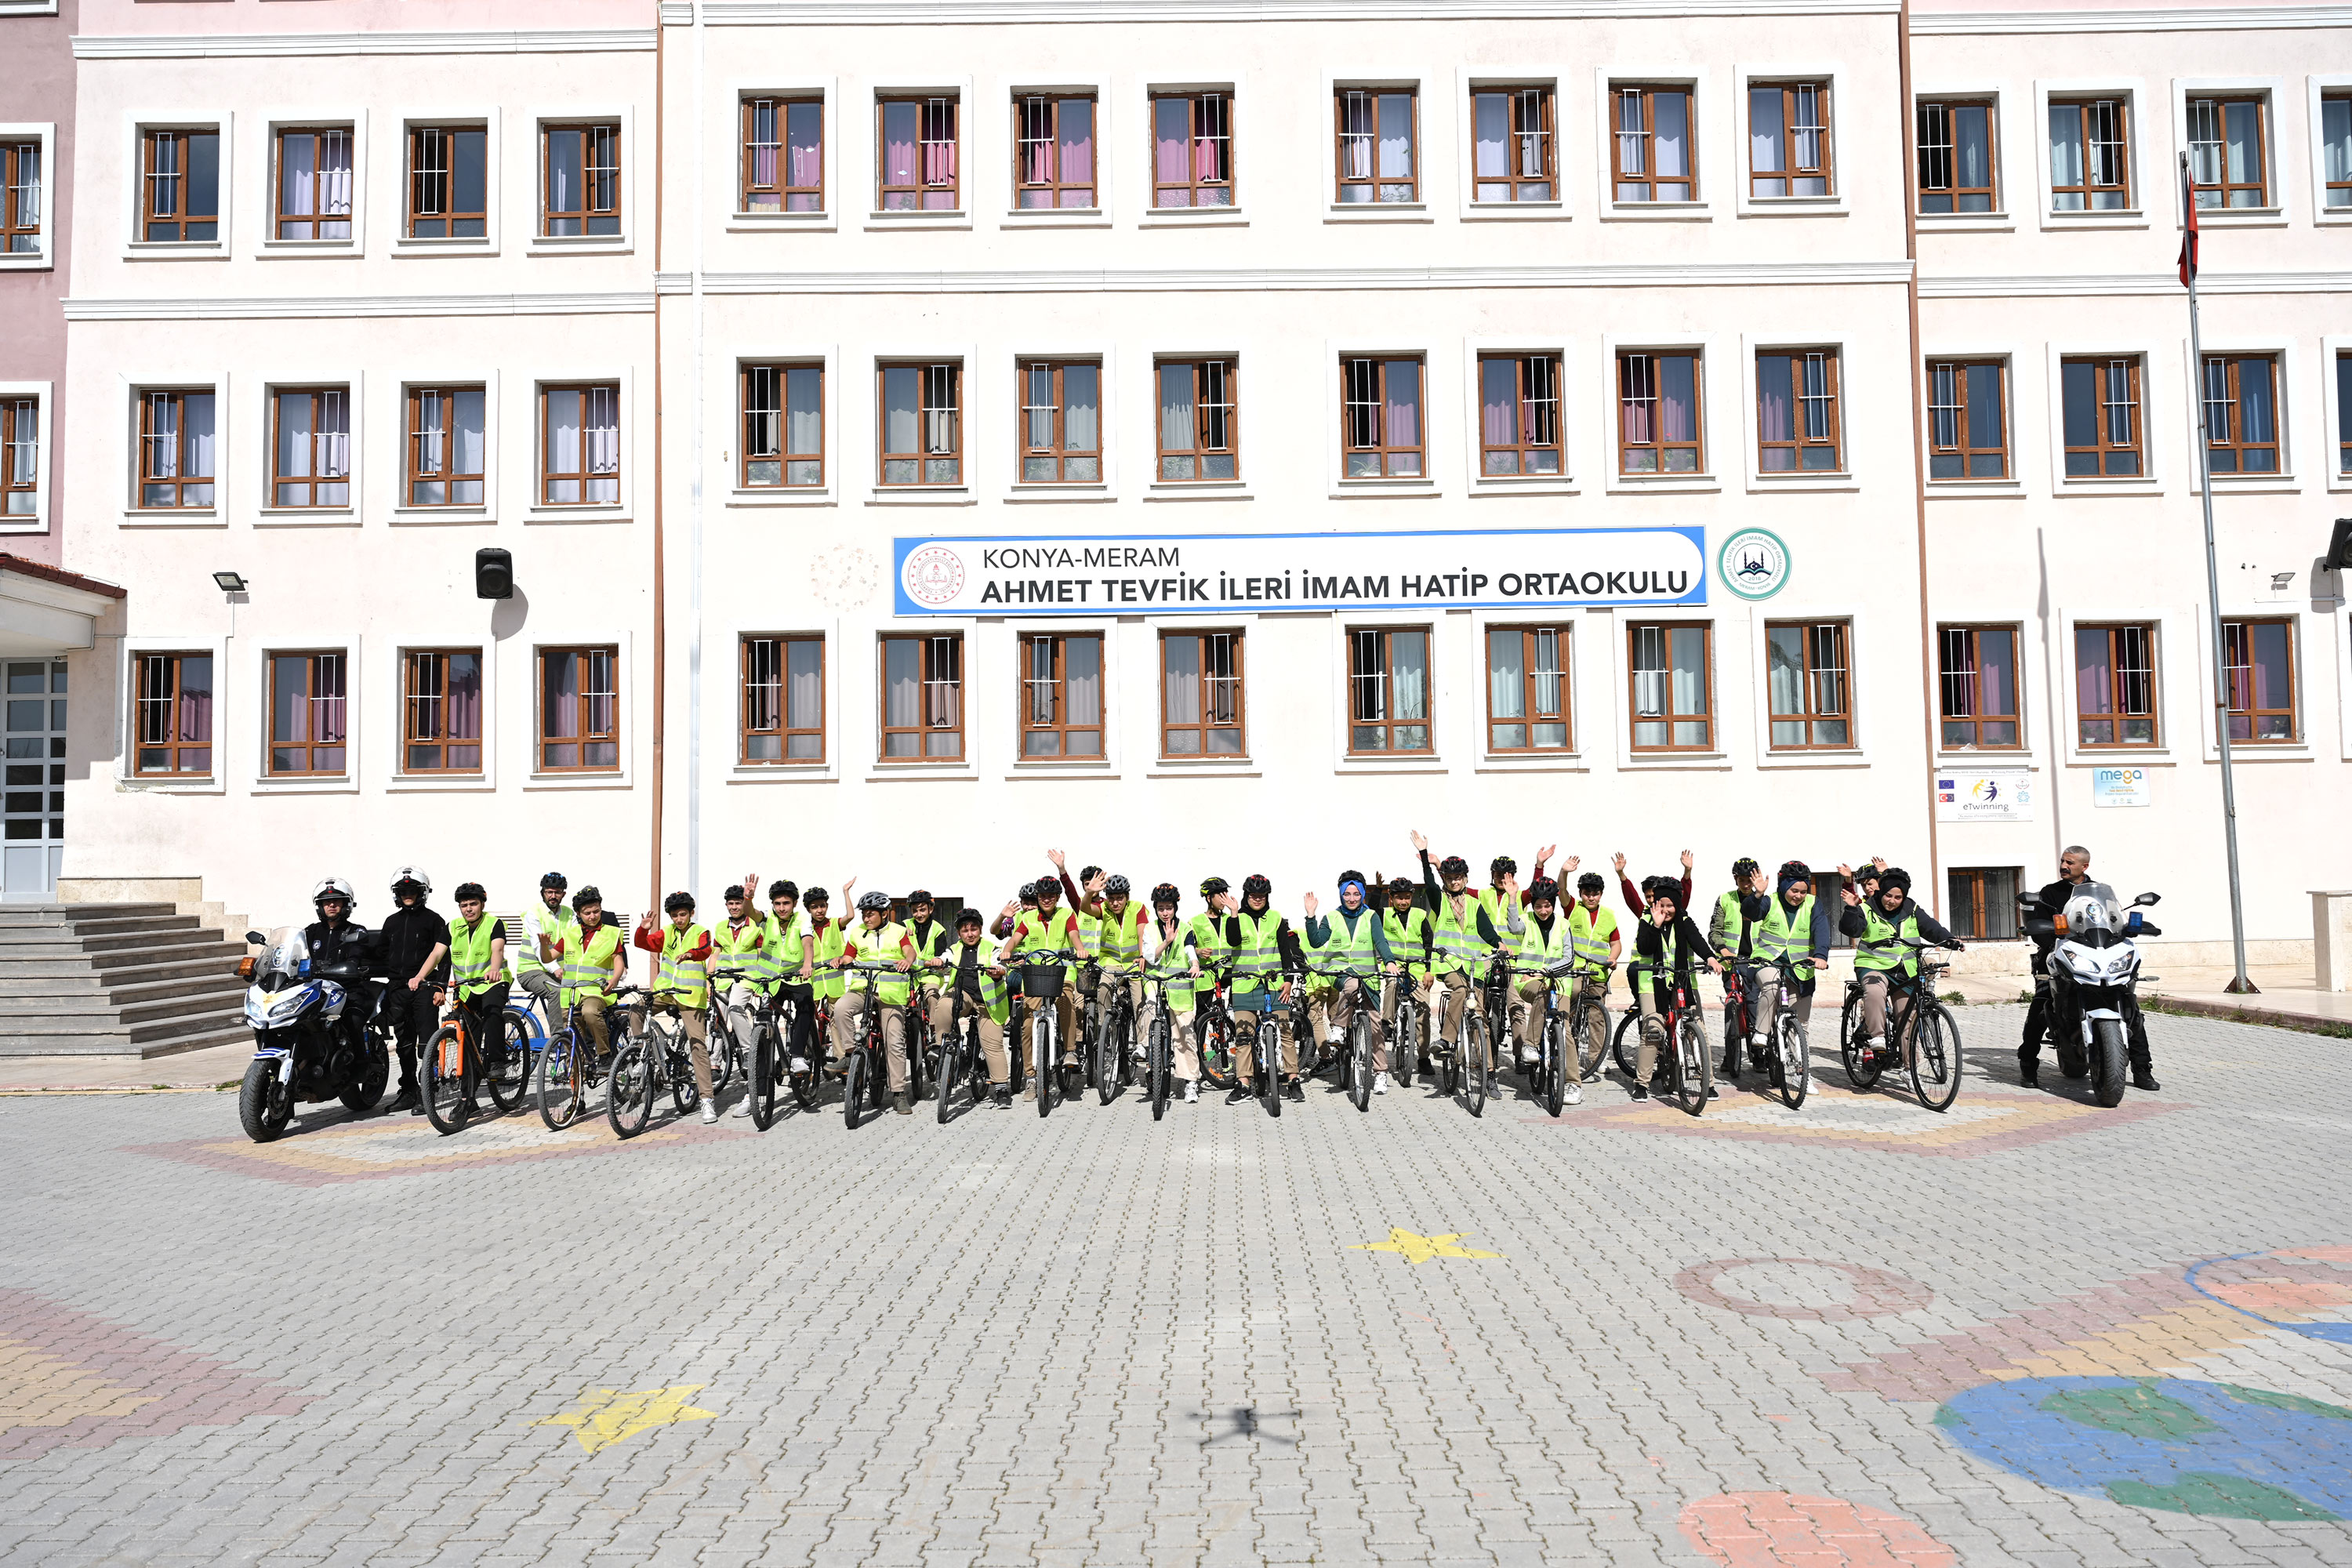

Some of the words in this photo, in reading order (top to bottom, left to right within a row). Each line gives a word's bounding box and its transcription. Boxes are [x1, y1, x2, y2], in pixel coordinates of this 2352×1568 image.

[985, 547, 1179, 568] KONYA-MERAM
[1772, 551, 1782, 582] ORTAOKULU
[981, 580, 1093, 603] AHMET
[1102, 572, 1209, 602] TEVFİK
[1221, 570, 1290, 601] İLERİ
[1303, 569, 1389, 599] İMAM
[1402, 567, 1488, 597] HATİP
[1499, 570, 1687, 597] ORTAOKULU
[2100, 770, 2142, 784] mega
[1962, 803, 2009, 812] eTwinning
